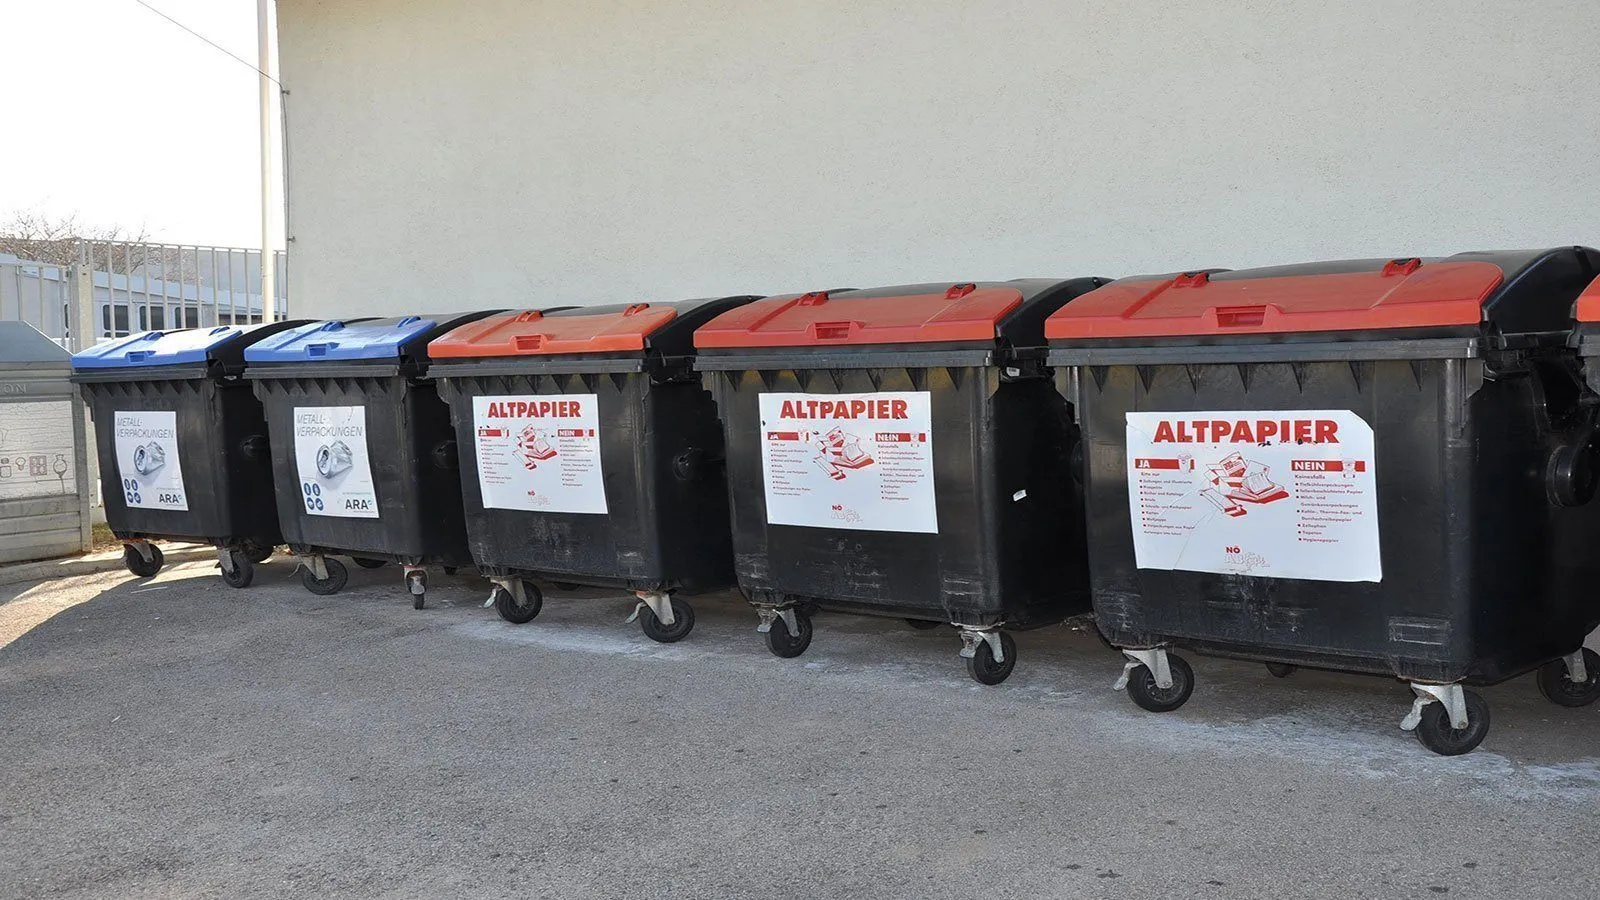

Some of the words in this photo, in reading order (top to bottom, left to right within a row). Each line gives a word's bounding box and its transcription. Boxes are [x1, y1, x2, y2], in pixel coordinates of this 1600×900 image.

[488, 401, 581, 418] ALTPAPIER
[780, 399, 908, 419] ALTPAPIER
[116, 417, 143, 427] METALL-
[296, 414, 326, 424] METALL-
[116, 428, 174, 439] VERPACKUNGEN
[296, 426, 363, 437] VERPACKUNGEN
[877, 433, 899, 441] NEIN
[1153, 420, 1340, 444] ALTPAPIER
[1138, 459, 1151, 469] JA
[1294, 461, 1326, 471] NEIN
[159, 494, 180, 504] ARA
[345, 499, 369, 510] ARA
[1225, 545, 1241, 554] NÖ
